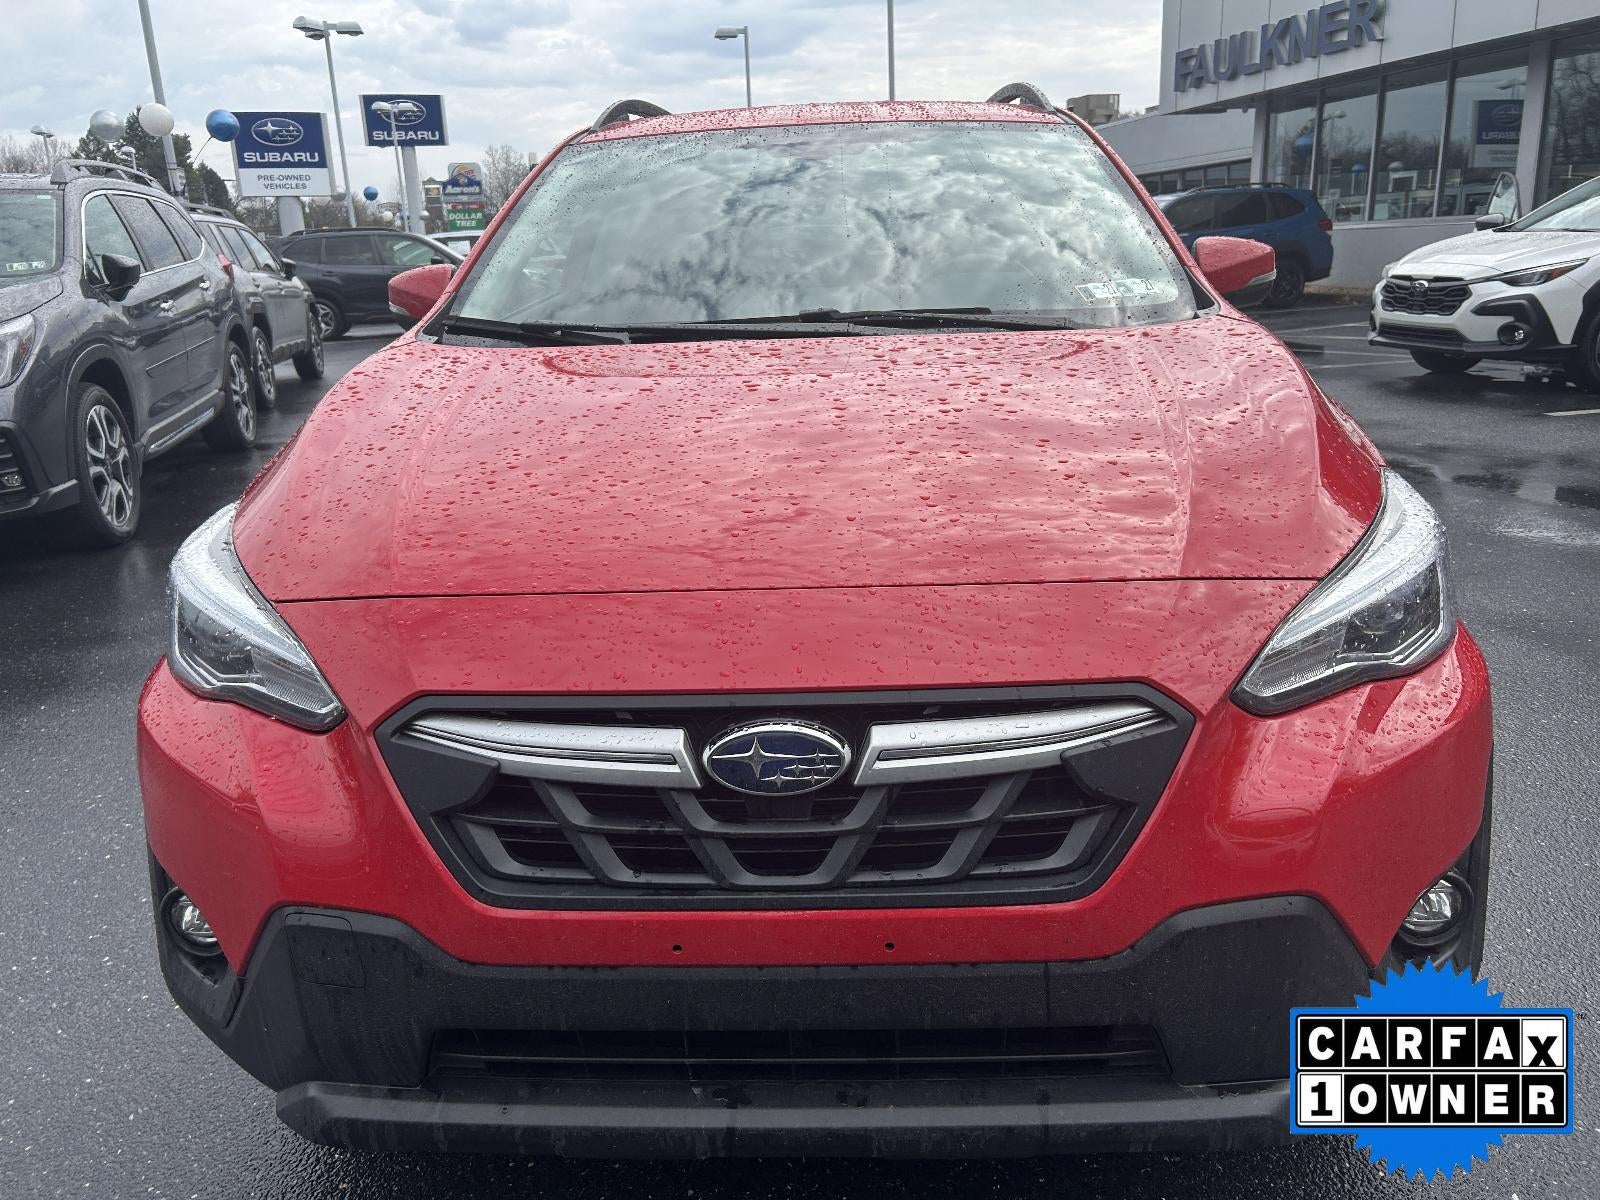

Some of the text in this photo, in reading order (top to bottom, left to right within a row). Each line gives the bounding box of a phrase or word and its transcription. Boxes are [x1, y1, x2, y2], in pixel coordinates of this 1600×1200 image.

[1174, 0, 1385, 92] FAULKNER
[372, 130, 440, 141] SUBARU
[243, 151, 320, 163] SUBARU
[257, 174, 311, 182] PRE-OWNED
[263, 182, 308, 190] VEHICLES
[448, 212, 483, 220] DOLLAR
